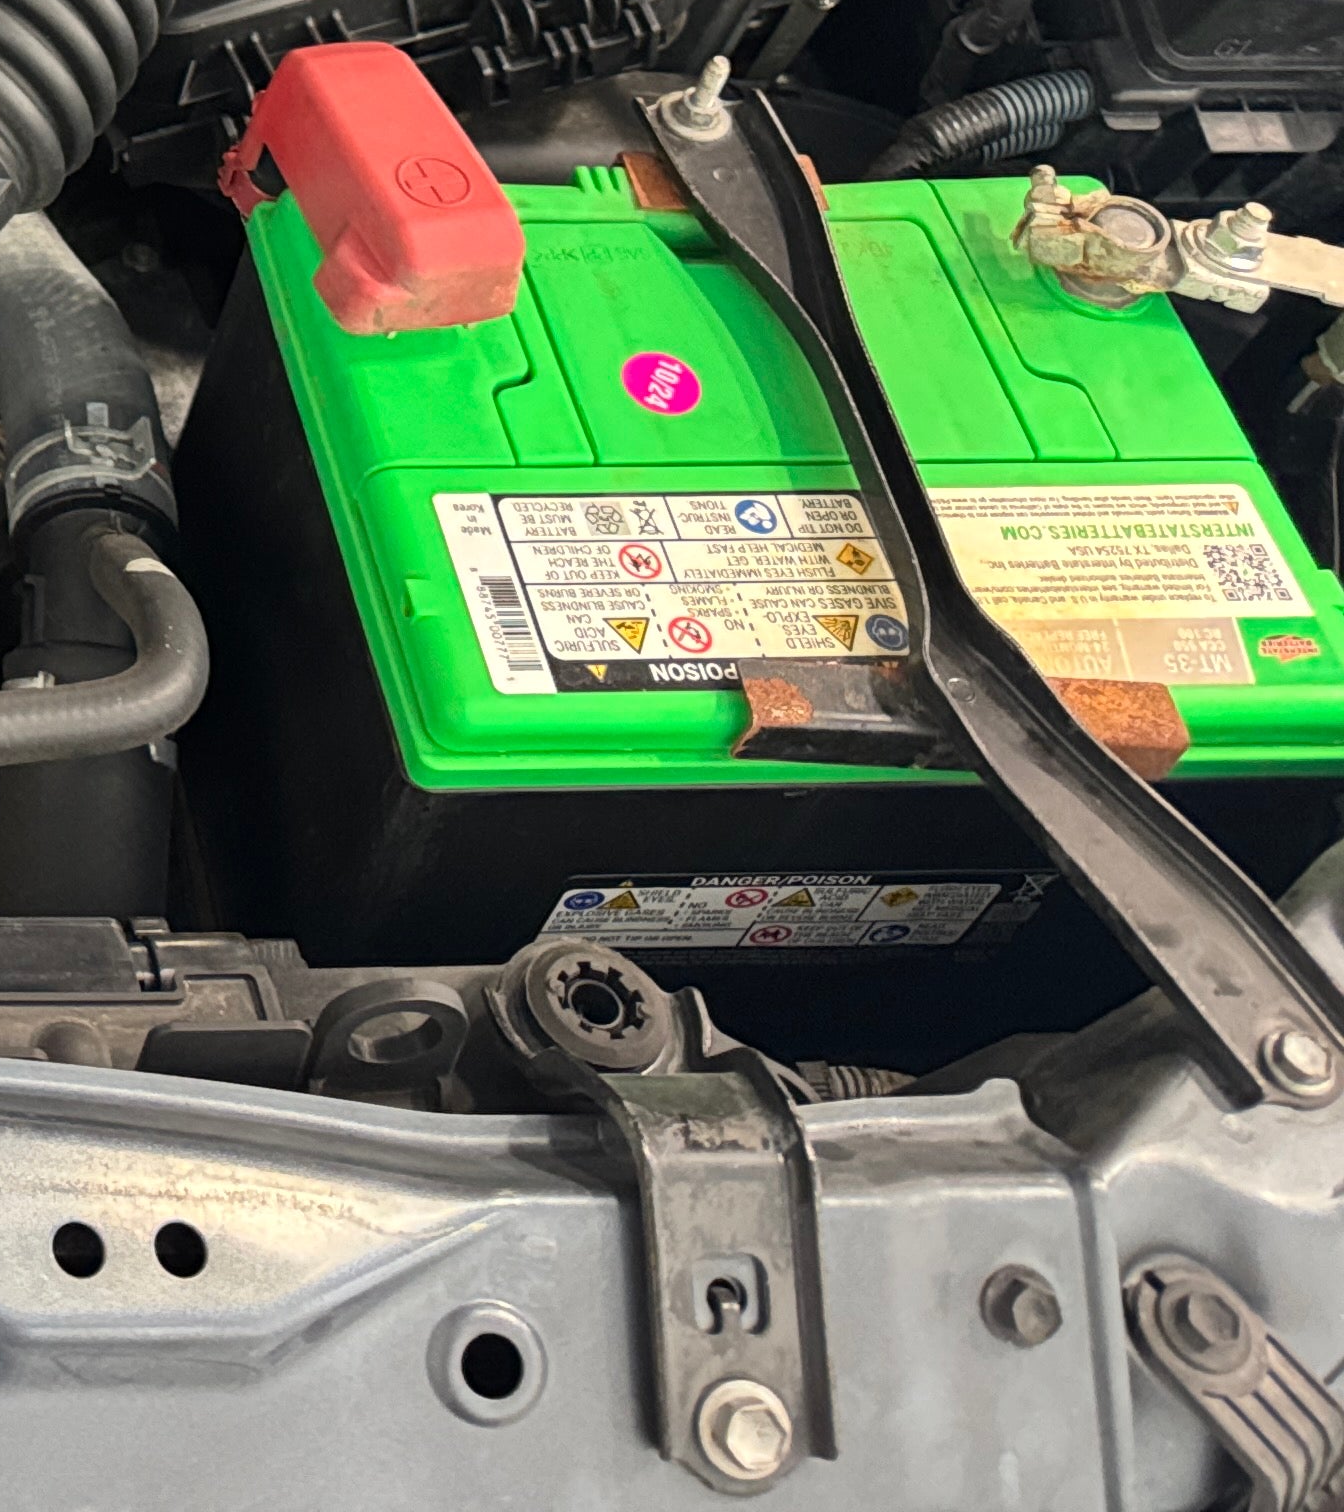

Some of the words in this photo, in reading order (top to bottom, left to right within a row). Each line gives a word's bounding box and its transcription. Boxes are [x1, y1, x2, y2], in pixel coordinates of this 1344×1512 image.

[644, 360, 682, 409] 10/24
[452, 503, 485, 513] Korea
[466, 514, 477, 523] in
[519, 514, 535, 524] BE
[538, 514, 572, 524] MUST
[677, 512, 731, 522] INSTRUC-
[804, 511, 837, 521] OPEN
[840, 510, 857, 521] OR
[461, 526, 492, 536] Made
[525, 526, 576, 536] BATTERY
[704, 524, 737, 535] READ
[798, 524, 817, 534] TIP
[819, 523, 843, 534] NOT
[845, 523, 864, 533] DO
[1000, 523, 1256, 541] INTERSTATEBATTERIES.COM
[532, 545, 592, 555] CHILDREN
[594, 544, 611, 554] OF
[737, 543, 768, 553] HELP
[771, 542, 825, 553] MEDICAL
[1067, 546, 1094, 557] USA
[1094, 545, 1133, 556] 75254
[1133, 545, 1151, 555] TX
[548, 558, 588, 567] REACH
[590, 557, 616, 567] THE
[726, 556, 749, 566] GET
[797, 554, 831, 566] WITH
[1062, 559, 1118, 569] Interstate
[1119, 557, 1134, 570] by
[1134, 558, 1199, 570] Distributed
[1008, 560, 1061, 571] Batteries
[545, 570, 556, 580] OF
[560, 570, 586, 580] OUT
[589, 569, 620, 580] KEEP
[684, 568, 762, 579] IMMEDIATELY
[764, 568, 793, 578] EYES
[797, 567, 835, 578] FLUSH
[537, 589, 576, 599] BURNS
[579, 588, 622, 598] SEVERE
[624, 588, 641, 597] OR
[669, 584, 723, 594] SMOKING
[765, 586, 805, 596] INJURY
[807, 585, 823, 595] OR
[825, 584, 890, 594] BLINDNESS
[541, 600, 603, 611] BLINDNESS
[605, 599, 645, 610] CAUSE
[681, 596, 727, 606] FLAMES
[749, 598, 791, 609] CAUSE
[793, 598, 816, 609] CAN
[818, 597, 862, 609] GASES
[866, 597, 896, 608] SIVE
[687, 608, 731, 617] SPARKS
[764, 610, 810, 622] EXPLO-
[566, 614, 592, 624] CAN
[724, 618, 743, 630] NO
[574, 627, 606, 638] ACID
[554, 639, 620, 652] SULFURIC
[786, 637, 835, 648] SHIELD
[1163, 653, 1233, 673] MT-35
[690, 875, 873, 887] DANGER/POISON
